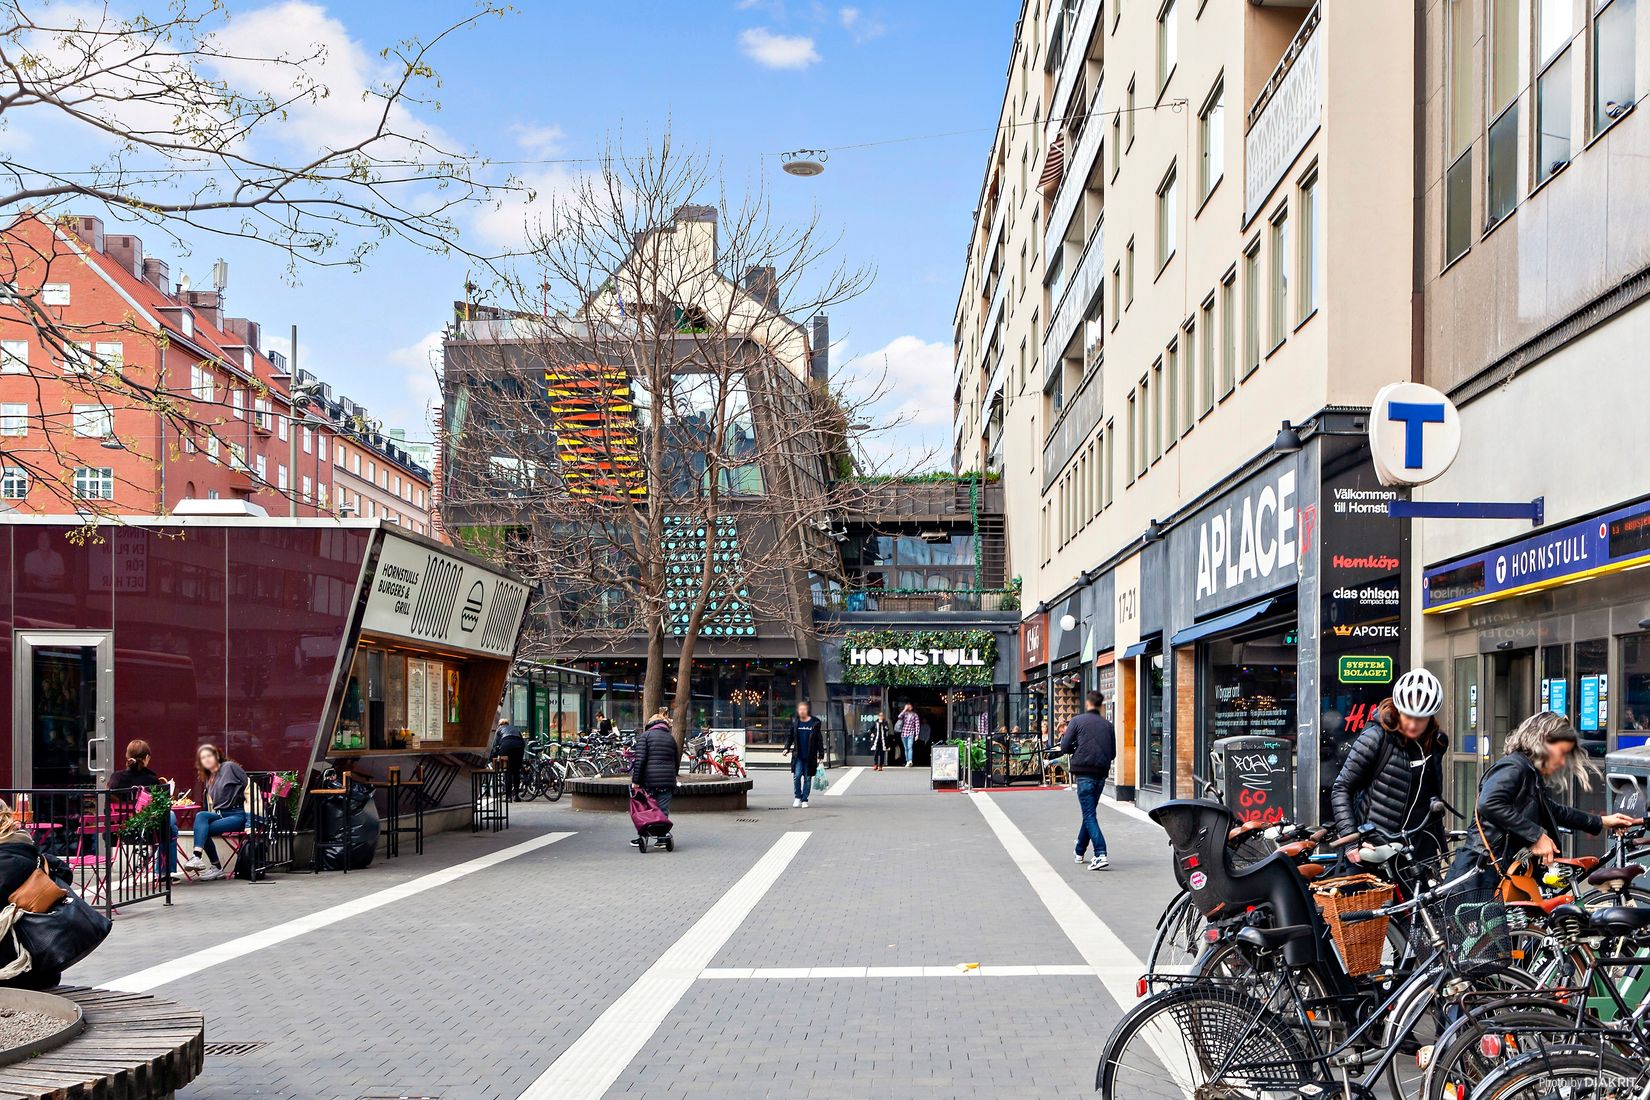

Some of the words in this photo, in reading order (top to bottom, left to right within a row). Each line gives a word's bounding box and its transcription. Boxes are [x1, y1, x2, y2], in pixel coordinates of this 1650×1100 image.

[1388, 401, 1445, 469] T
[1333, 488, 1396, 500] Välkommen
[1333, 502, 1346, 513] till
[1349, 502, 1389, 513] Hornstu
[1195, 469, 1295, 601] APLACE
[1332, 555, 1399, 570] Hemköp
[1511, 535, 1588, 577] HORNSTULL
[382, 563, 419, 585] HORNSTULLS
[378, 579, 405, 598] BURGERS
[405, 587, 410, 599] &
[1333, 587, 1358, 599] clas
[1360, 587, 1399, 599] ohlson
[394, 600, 410, 615] GRILL
[1353, 626, 1399, 637] APOTEK
[850, 648, 985, 666] HORNSTULL
[1346, 661, 1385, 669] SYSTEM
[1343, 669, 1388, 677] BOLAGET
